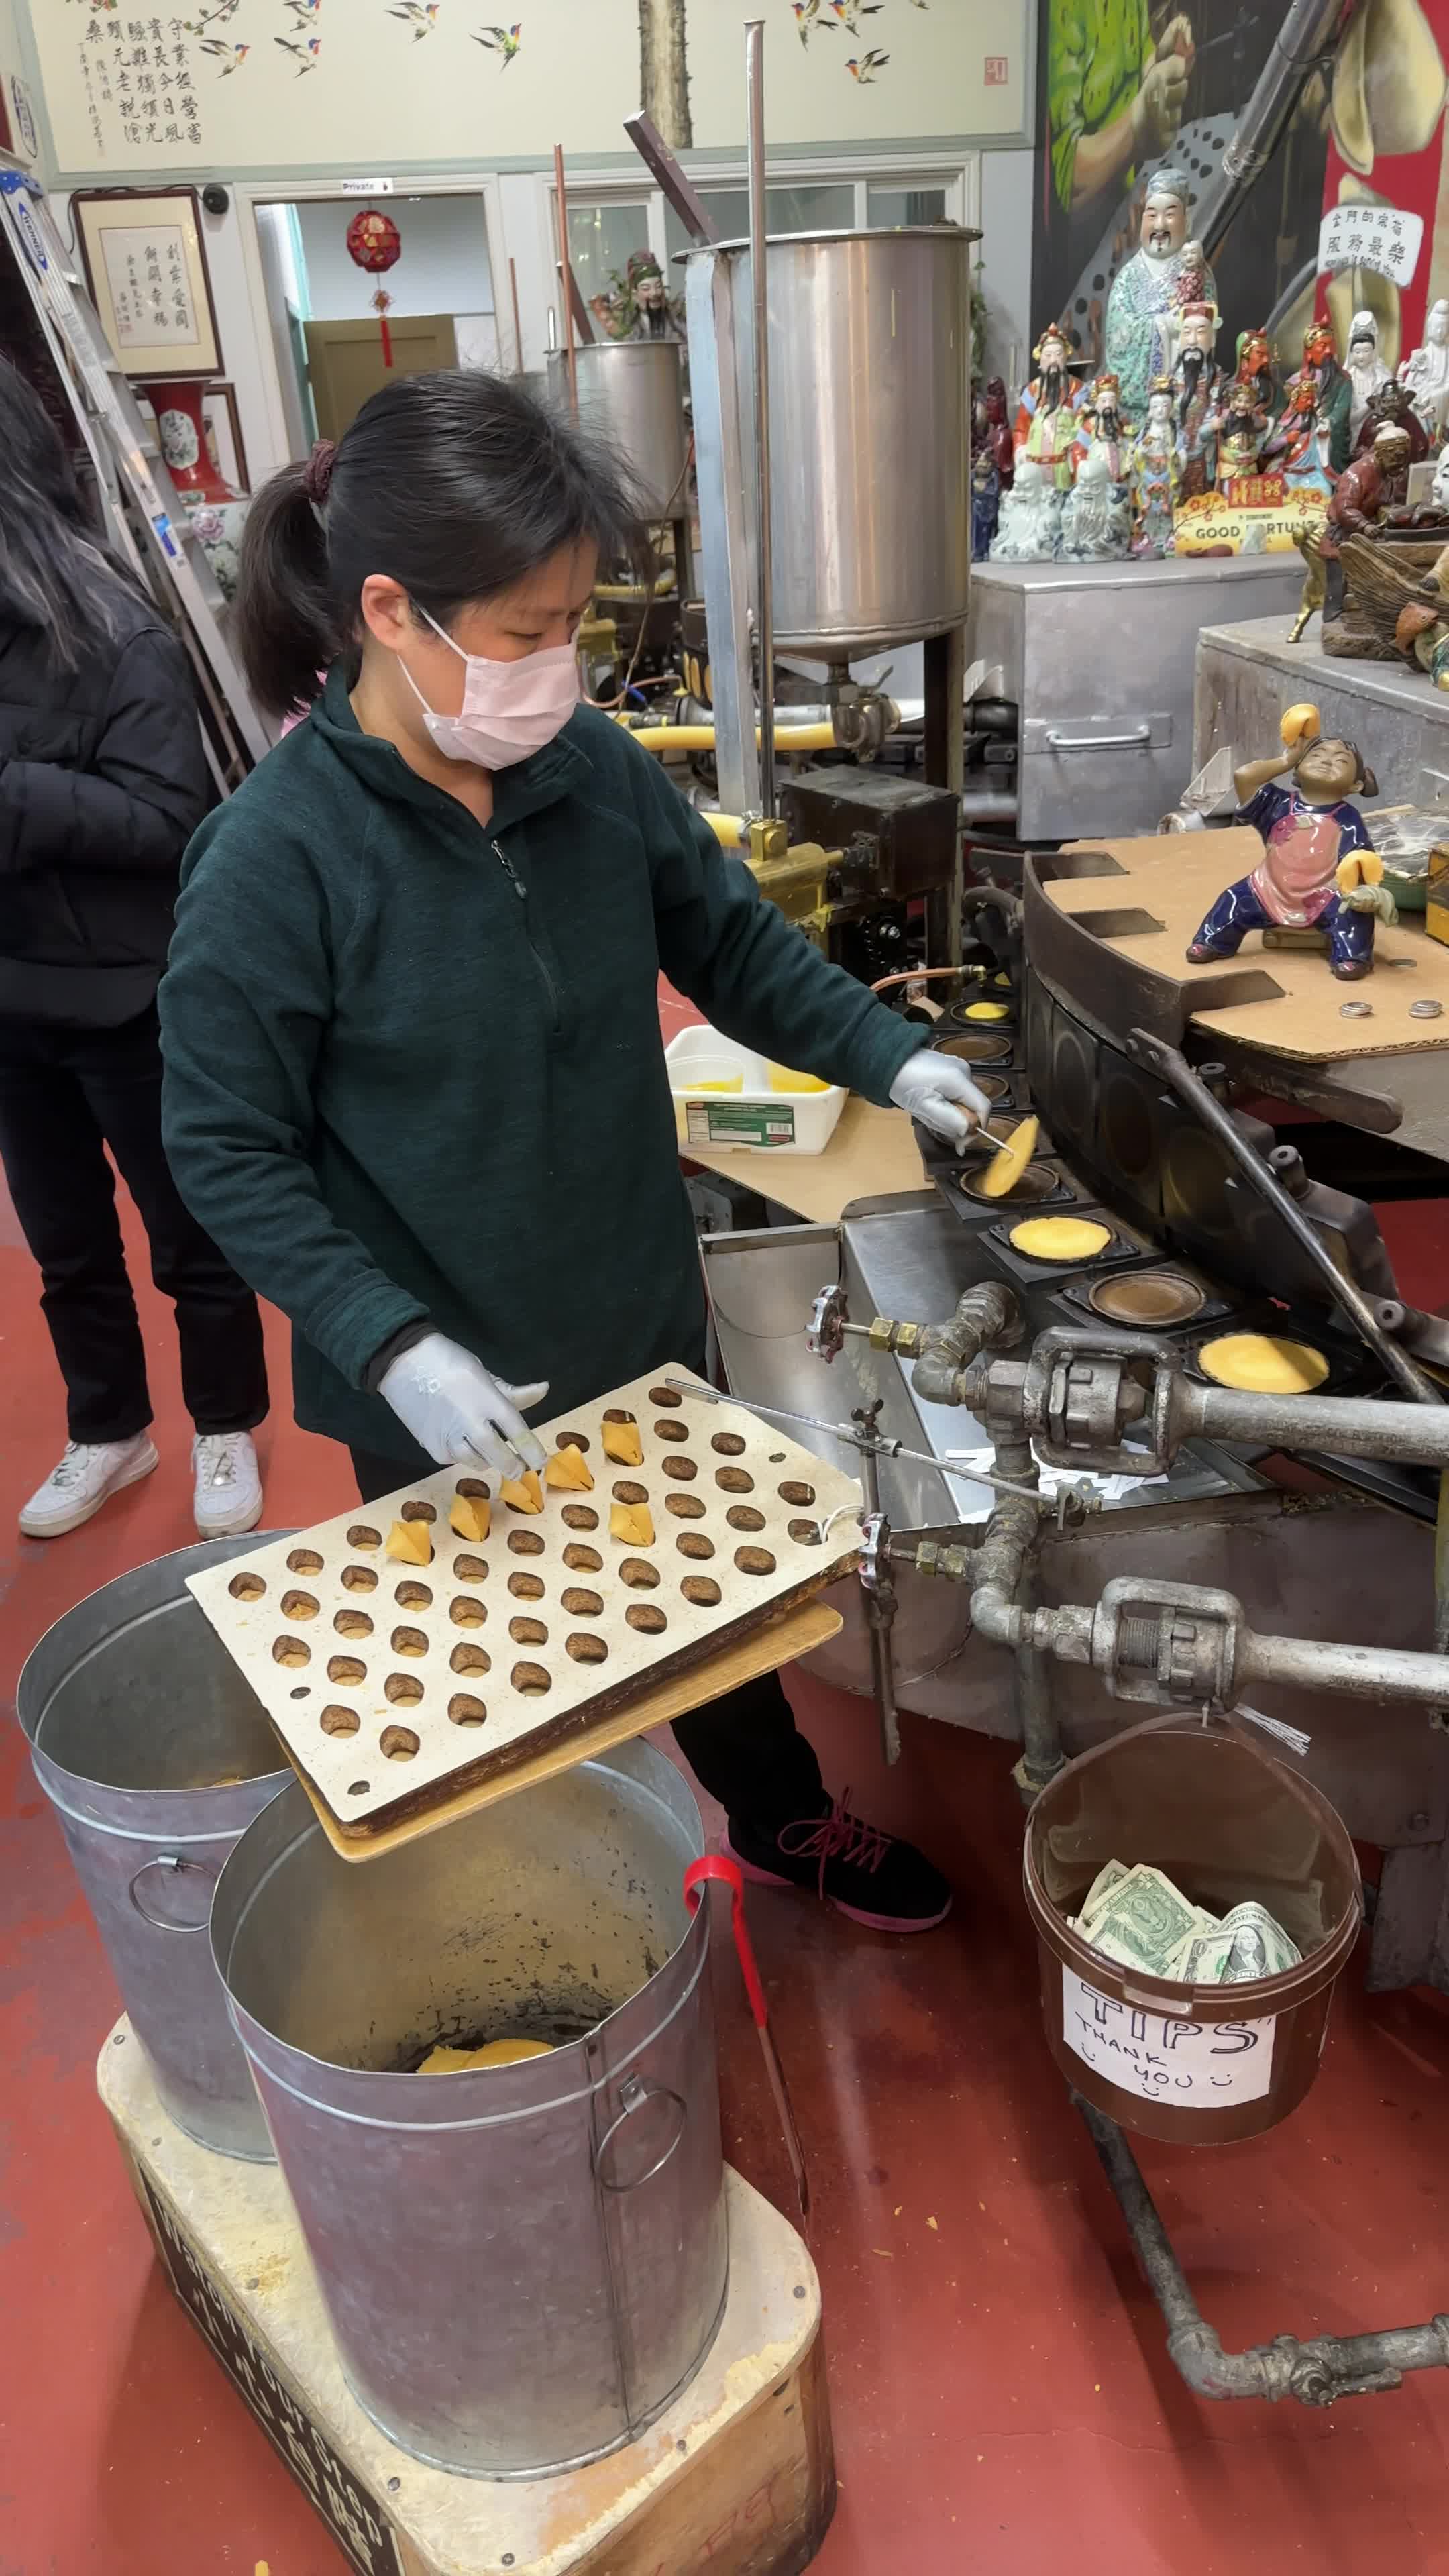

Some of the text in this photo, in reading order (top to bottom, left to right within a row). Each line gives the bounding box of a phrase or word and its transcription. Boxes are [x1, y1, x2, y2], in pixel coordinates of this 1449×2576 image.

[1196, 526, 1240, 539] GOOD
[1075, 2010, 1167, 2066] THANK
[1134, 2064, 1193, 2087] YOU
[311, 2426, 382, 2548] Step
